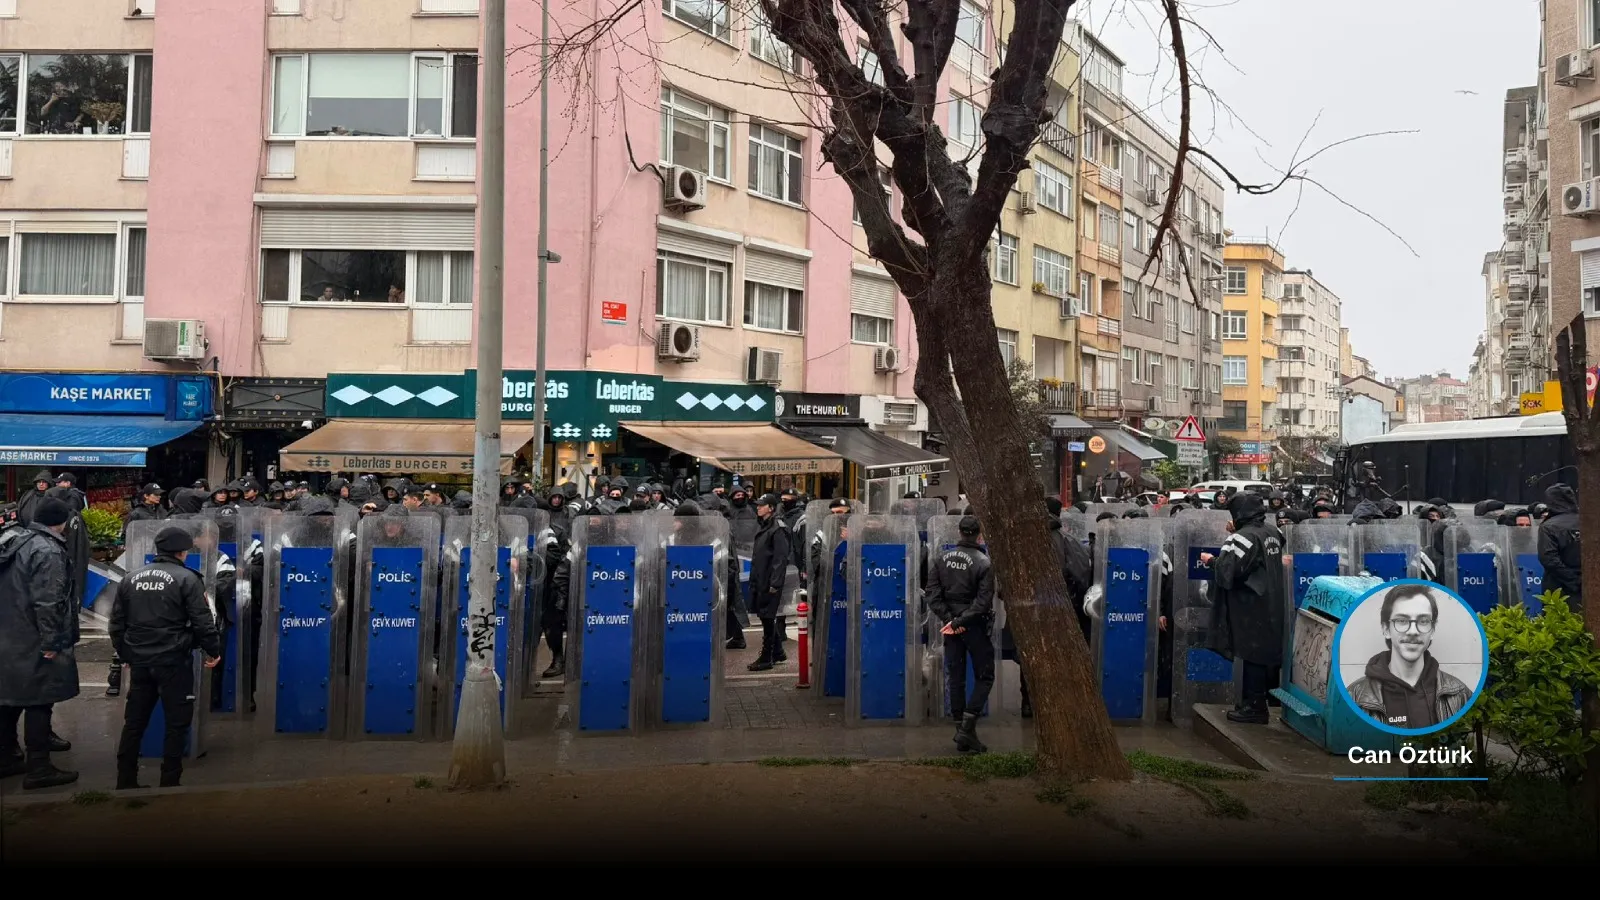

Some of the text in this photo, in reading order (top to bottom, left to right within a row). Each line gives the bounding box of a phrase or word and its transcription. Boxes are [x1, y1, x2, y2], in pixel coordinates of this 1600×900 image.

[596, 377, 655, 402] Leberkäs
[49, 387, 152, 404] KAŞE MARKET
[501, 402, 548, 412] BURGR
[608, 403, 642, 414] BURGER
[796, 404, 812, 415] THE
[0, 451, 58, 463] AŞE MARKET
[395, 459, 448, 470] BURGER
[777, 462, 802, 471] BURGER
[889, 466, 901, 477] THE
[1112, 569, 1141, 581] POİS
[391, 617, 416, 628] KUVVET
[685, 613, 709, 623] KUVVET
